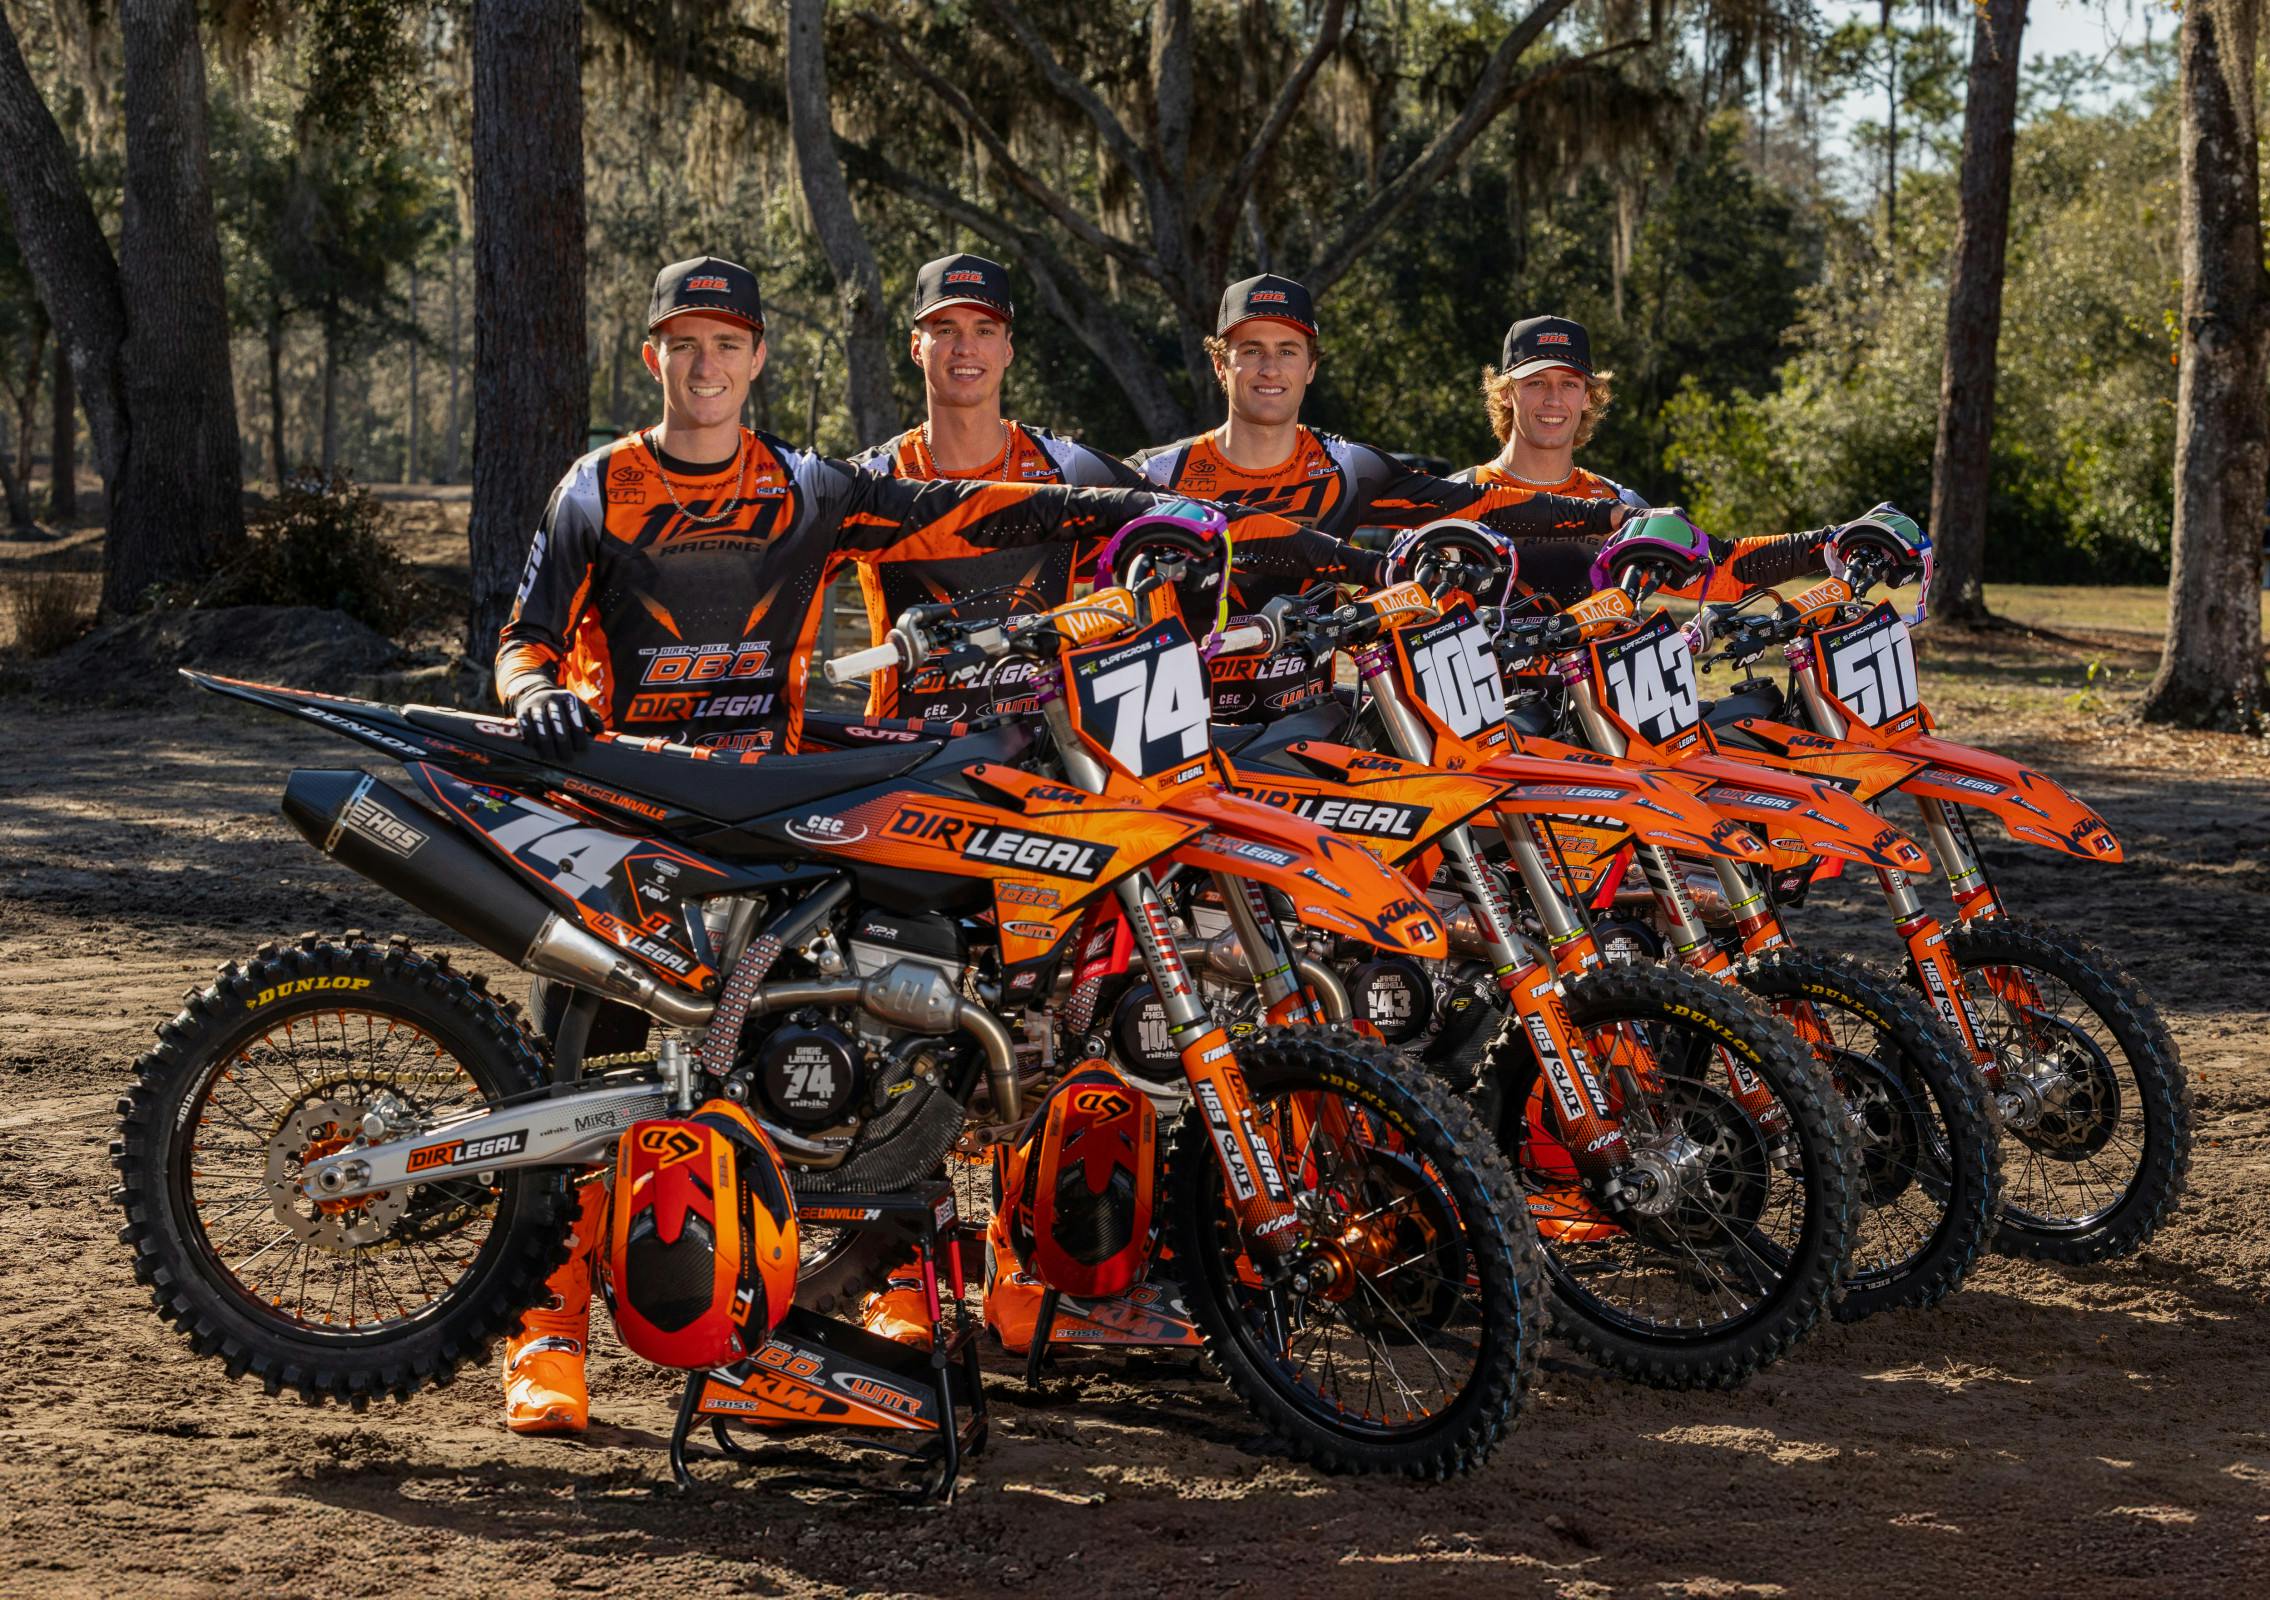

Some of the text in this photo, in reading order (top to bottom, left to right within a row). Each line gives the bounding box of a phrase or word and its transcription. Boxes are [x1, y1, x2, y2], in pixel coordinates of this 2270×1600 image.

[659, 540, 762, 556] RACING
[643, 651, 769, 683] DBD
[949, 661, 986, 685] ASV
[1506, 656, 1533, 674] ASV
[1738, 650, 1764, 667] ASV
[1832, 620, 1919, 728] 511
[1414, 624, 1505, 738] 105
[1607, 632, 1699, 739] 143
[1092, 641, 1212, 777] 74
[1219, 694, 1241, 704] CEC
[300, 706, 428, 757] DUNLOP
[843, 727, 919, 742] GUTS
[1787, 736, 1835, 750] KTM
[1347, 756, 1403, 772] KTM
[563, 778, 668, 822] GAGELINVILLE
[1026, 784, 1087, 806] KTM
[364, 811, 422, 849] HGS
[806, 815, 845, 833] CEC
[2070, 818, 2100, 842] KTM
[488, 796, 642, 900] 74
[638, 885, 670, 902] ASV
[645, 915, 671, 939] DL
[867, 923, 897, 936] XPR
[1378, 898, 1425, 930] KTM
[1408, 923, 1434, 942] DL
[257, 975, 371, 1007] DUNLOP
[1367, 990, 1412, 1018] 143
[1526, 1016, 1556, 1052] HGS
[783, 1064, 836, 1099] 74
[1197, 1083, 1227, 1123] HGS
[412, 1136, 522, 1168] DIRTLEGAL
[743, 1374, 826, 1417] KTM
[851, 1379, 922, 1416] WMR
